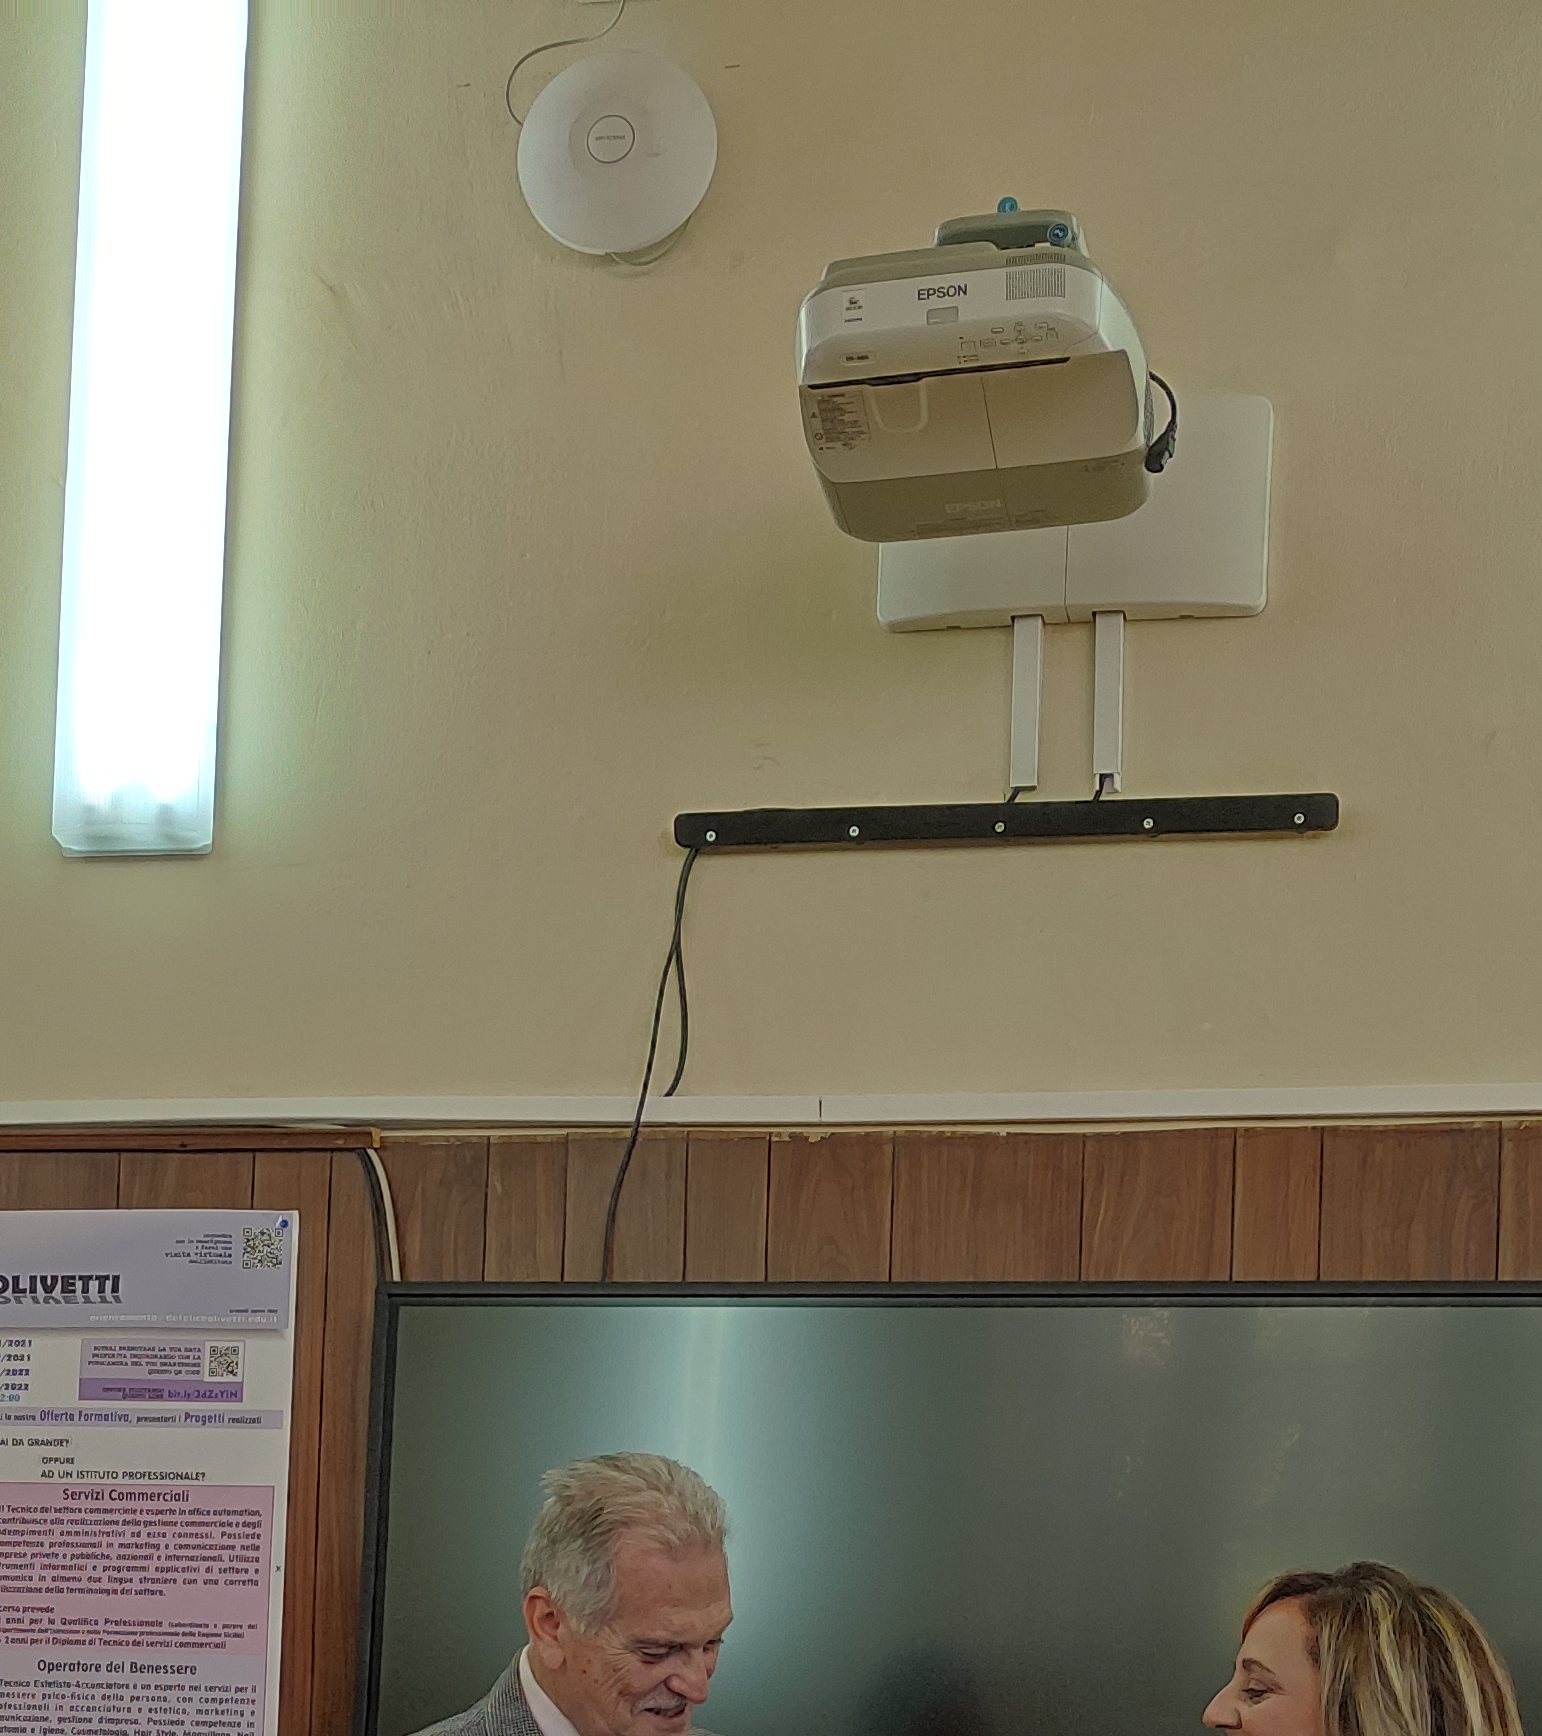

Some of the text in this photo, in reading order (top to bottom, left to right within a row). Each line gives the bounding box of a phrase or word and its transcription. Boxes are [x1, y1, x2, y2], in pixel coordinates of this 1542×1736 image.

[917, 283, 967, 301] EPSON
[39, 1410, 75, 1422] Offerta
[184, 1412, 225, 1425] Progetti
[41, 1470, 205, 1481] AD UN ISTITUTO PROFESSIONALE?
[62, 1488, 190, 1502] Servizi Commerciali
[37, 1659, 197, 1676] Operatore del Benessere
